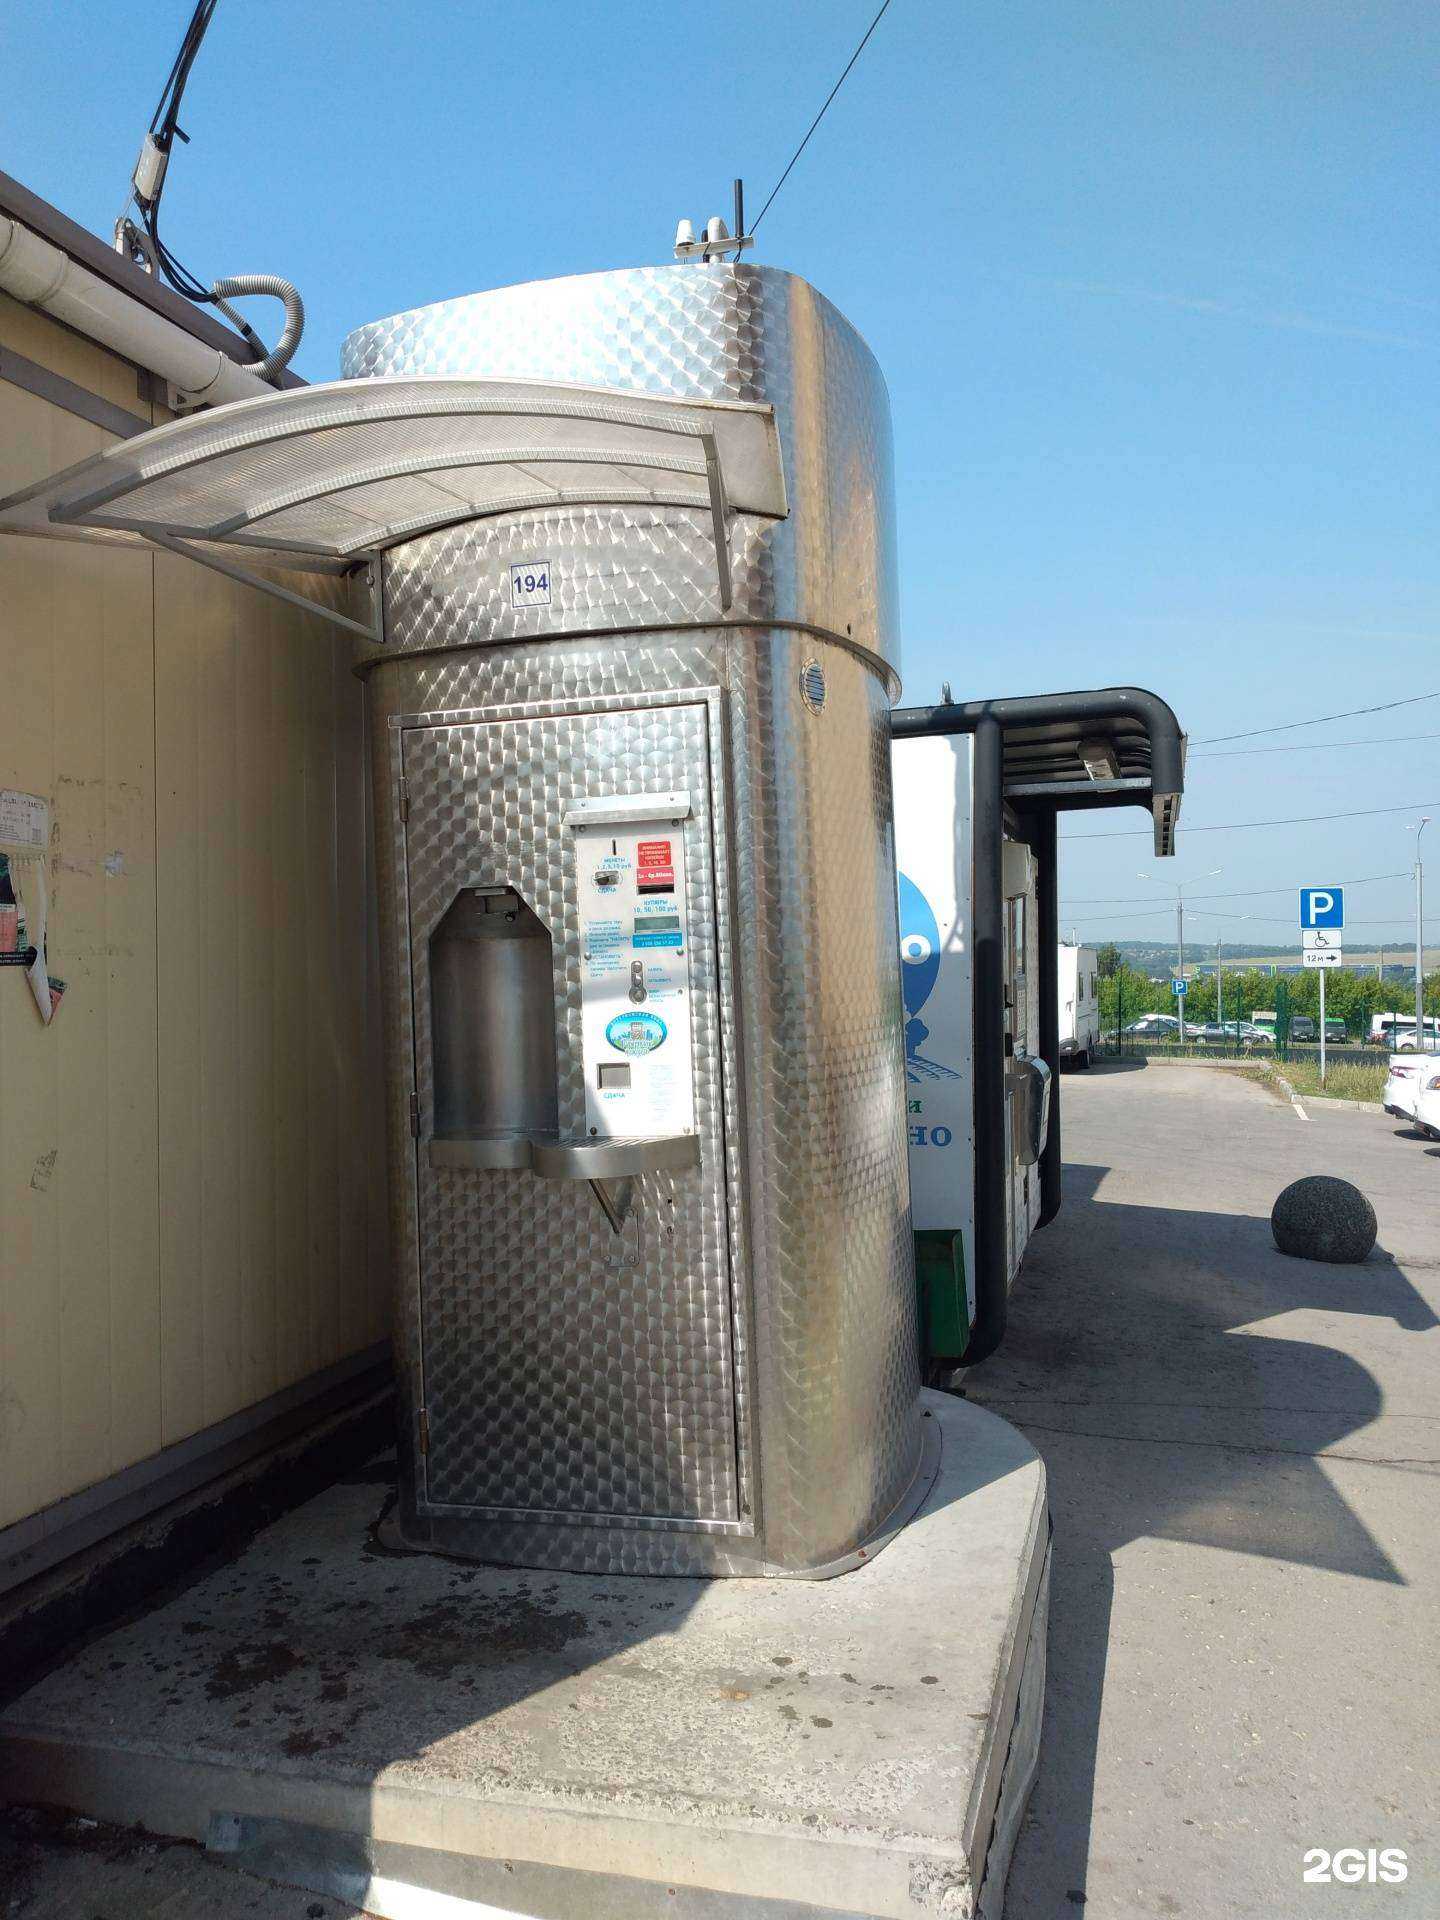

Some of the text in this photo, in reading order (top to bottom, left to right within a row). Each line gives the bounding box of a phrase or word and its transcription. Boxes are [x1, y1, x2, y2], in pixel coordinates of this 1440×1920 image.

[514, 573, 548, 593] 194
[1309, 891, 1334, 925] P
[1176, 981, 1184, 993] P
